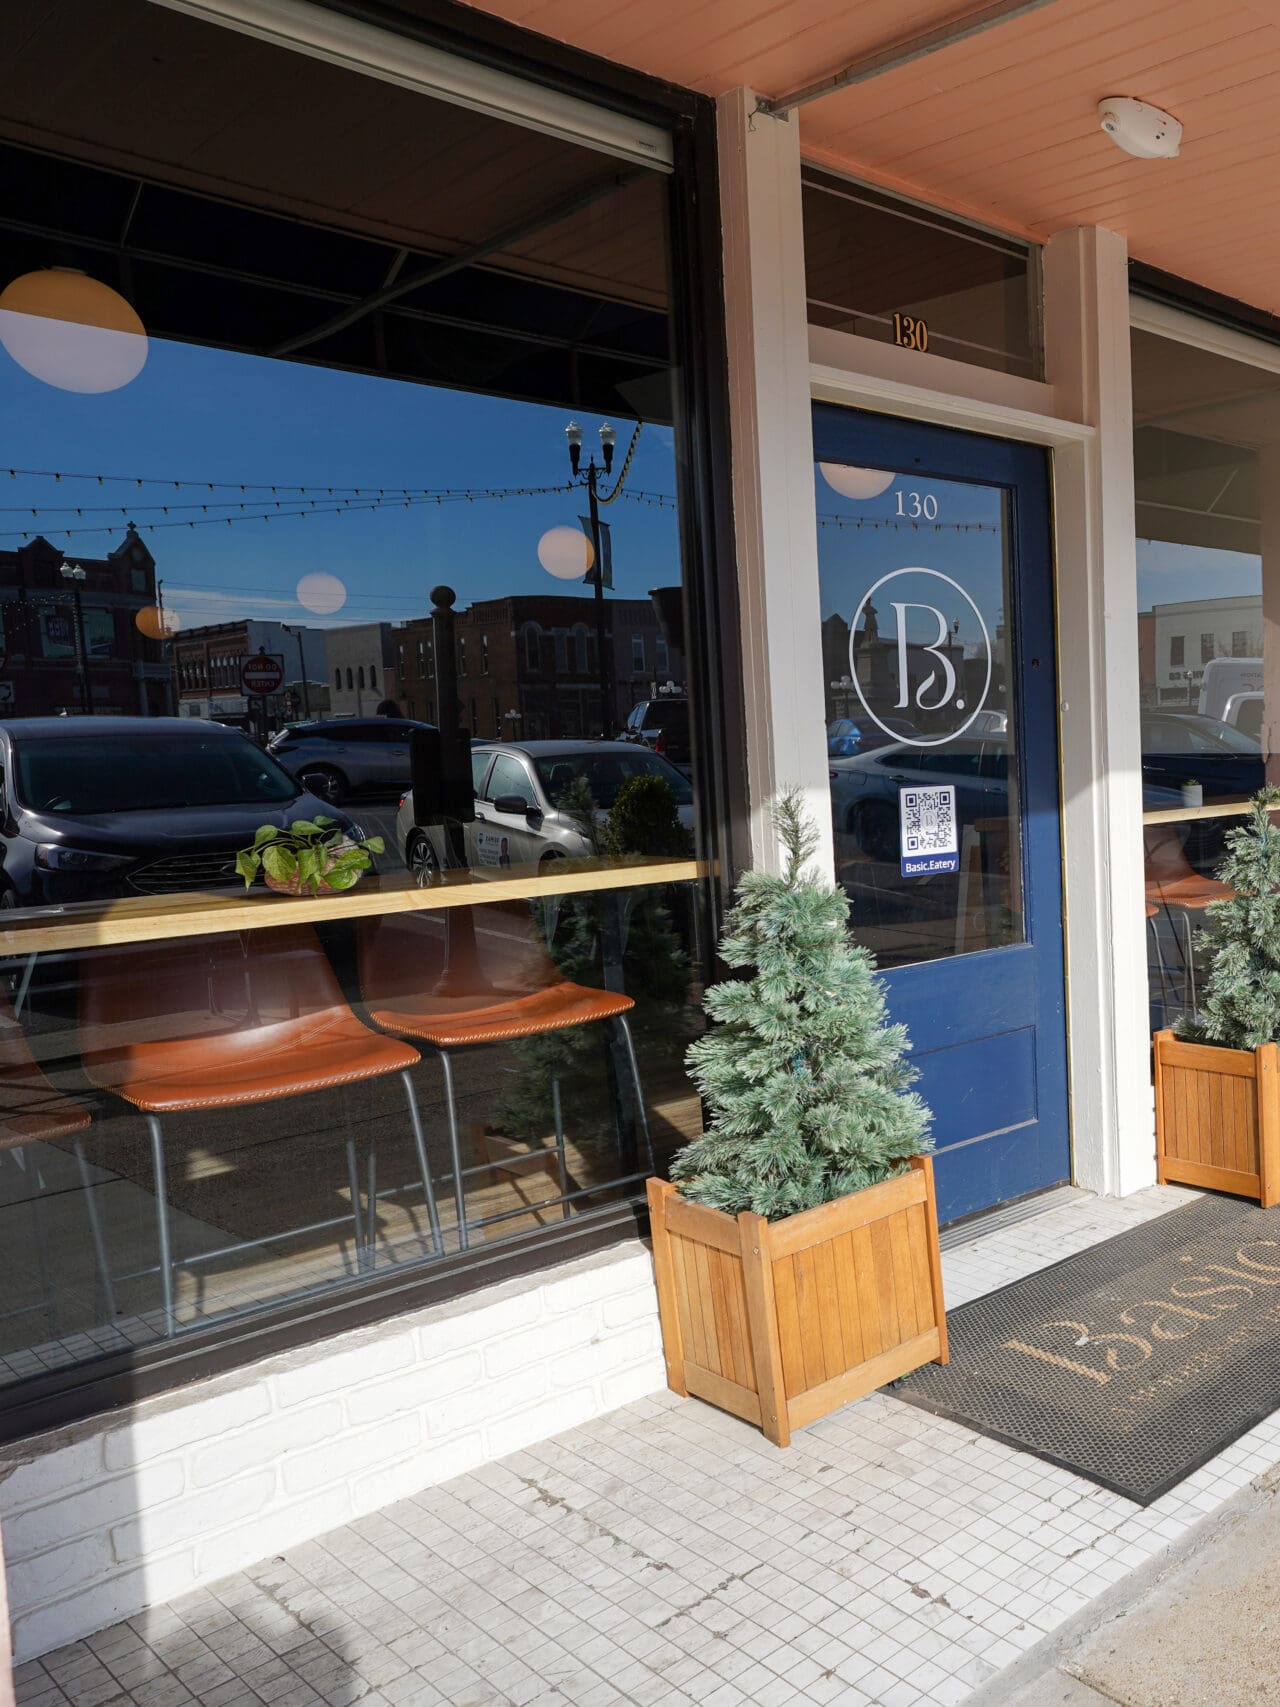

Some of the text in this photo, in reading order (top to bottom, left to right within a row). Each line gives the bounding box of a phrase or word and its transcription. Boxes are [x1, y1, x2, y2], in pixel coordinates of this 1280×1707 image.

[893, 312, 929, 352] 130
[895, 490, 938, 520] 130
[905, 859, 956, 873] Basic.Eatery
